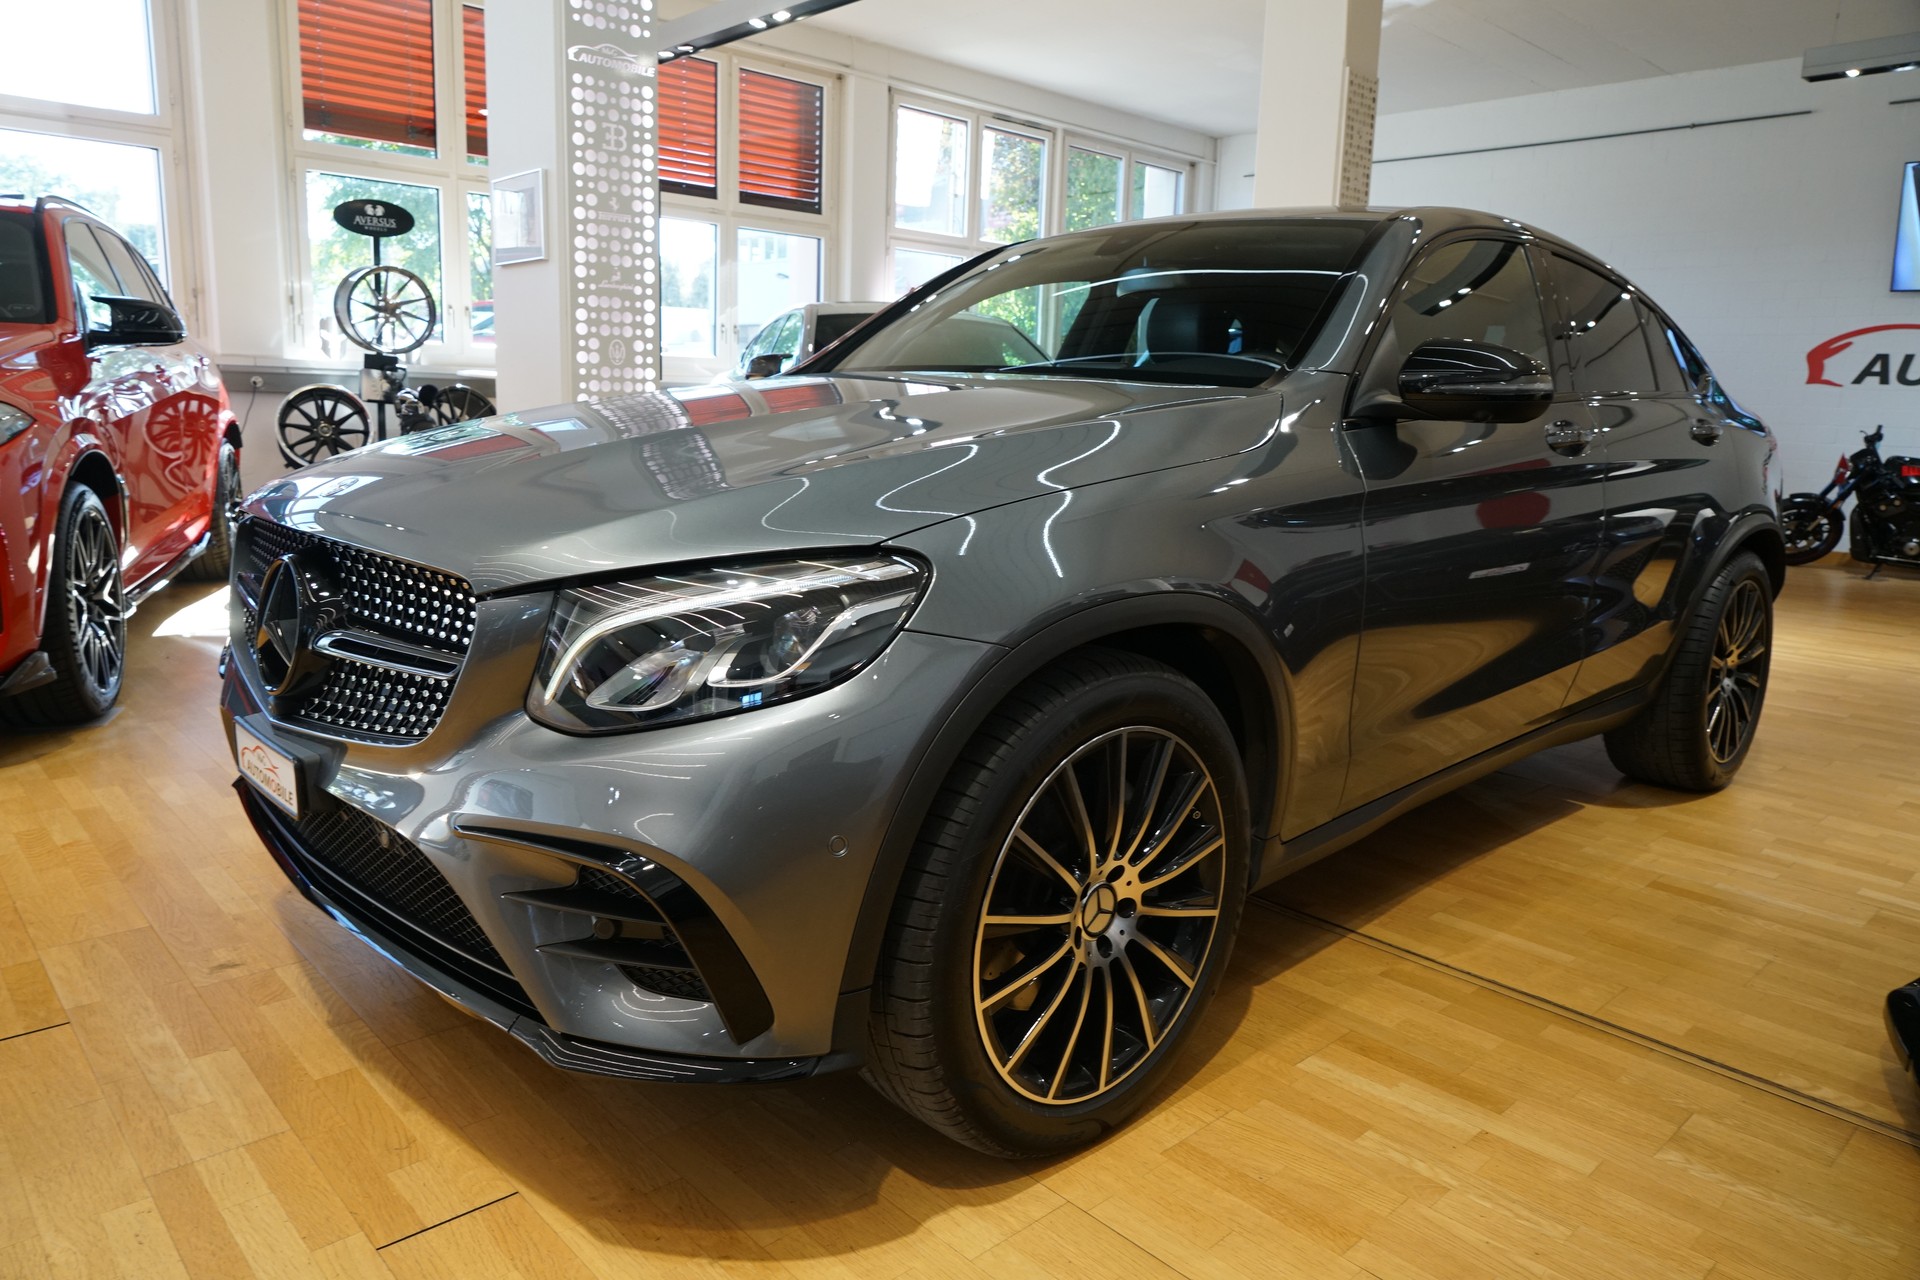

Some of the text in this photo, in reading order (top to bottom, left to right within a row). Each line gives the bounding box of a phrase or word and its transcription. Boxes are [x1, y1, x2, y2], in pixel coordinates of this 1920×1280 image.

[579, 53, 656, 78] AUTOMOBILE
[353, 215, 397, 228] AVERSUS
[247, 759, 294, 806] AUTOMOBILE
